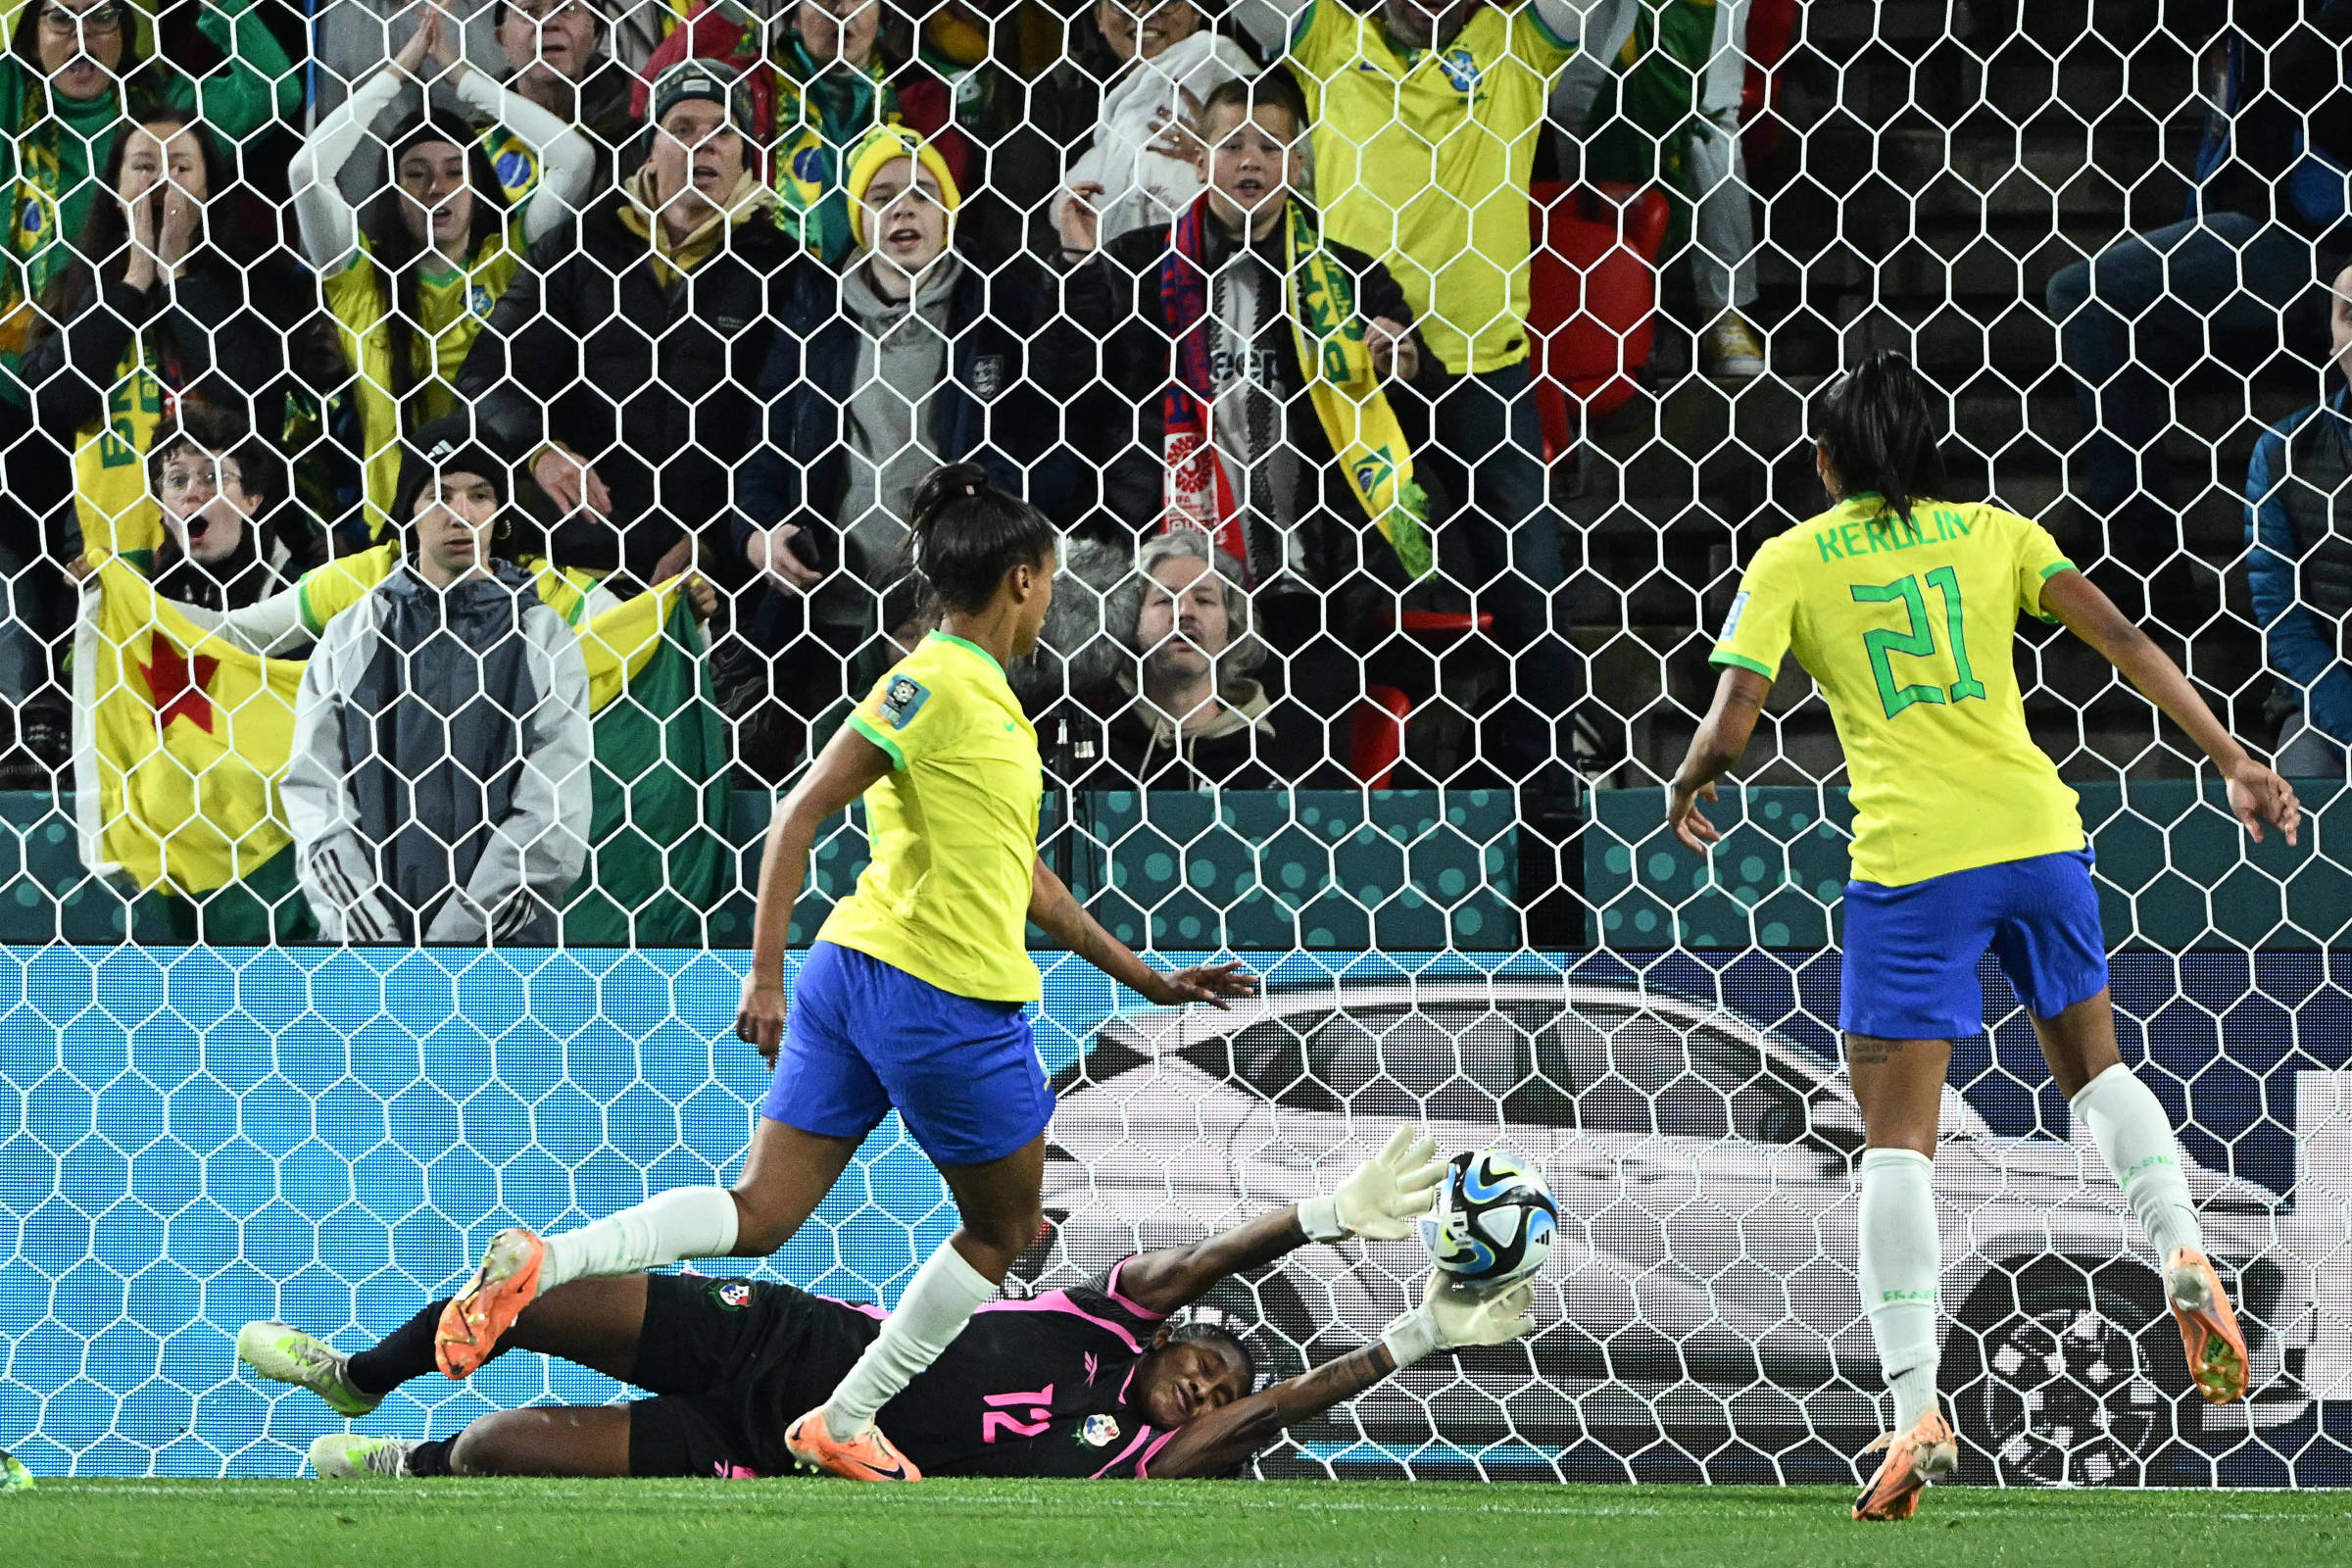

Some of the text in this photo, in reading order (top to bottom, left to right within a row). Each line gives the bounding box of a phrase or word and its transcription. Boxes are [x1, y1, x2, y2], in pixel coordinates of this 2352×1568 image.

[1815, 510, 1970, 563] KEROLIN
[1849, 565, 1986, 720] 21
[982, 1383, 1054, 1444] 12
